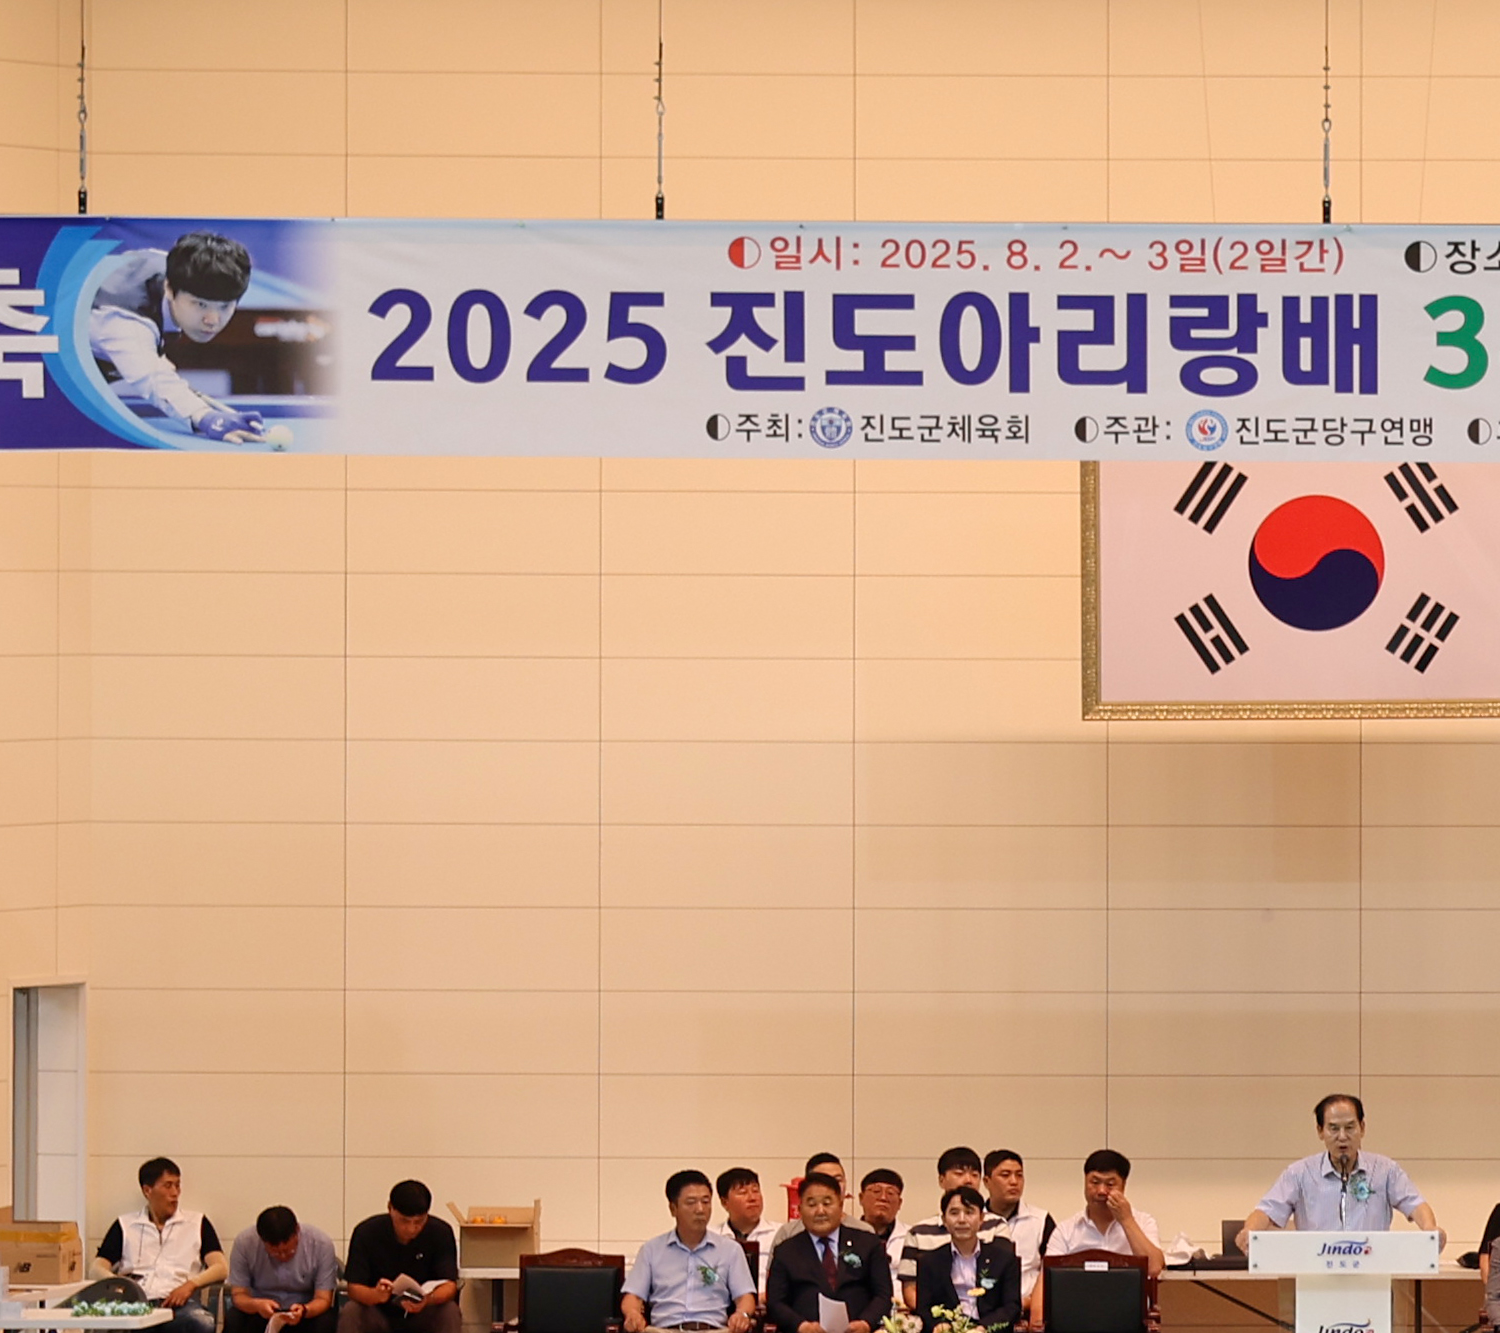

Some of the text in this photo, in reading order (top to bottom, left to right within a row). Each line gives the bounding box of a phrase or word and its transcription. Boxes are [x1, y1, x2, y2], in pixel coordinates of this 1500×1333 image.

[769, 235, 861, 271] 일시:
[879, 238, 992, 271] 2025.
[1006, 238, 1043, 271] 8.
[1147, 236, 1346, 276] 3일(2일간)
[367, 288, 669, 385] 2025
[704, 289, 1381, 398] 진도아리랑배
[734, 410, 1031, 446] 주최: 진도군체육회
[1102, 411, 1434, 448] 주관: 진도군당구연맹
[1317, 1238, 1366, 1256] Jindo
